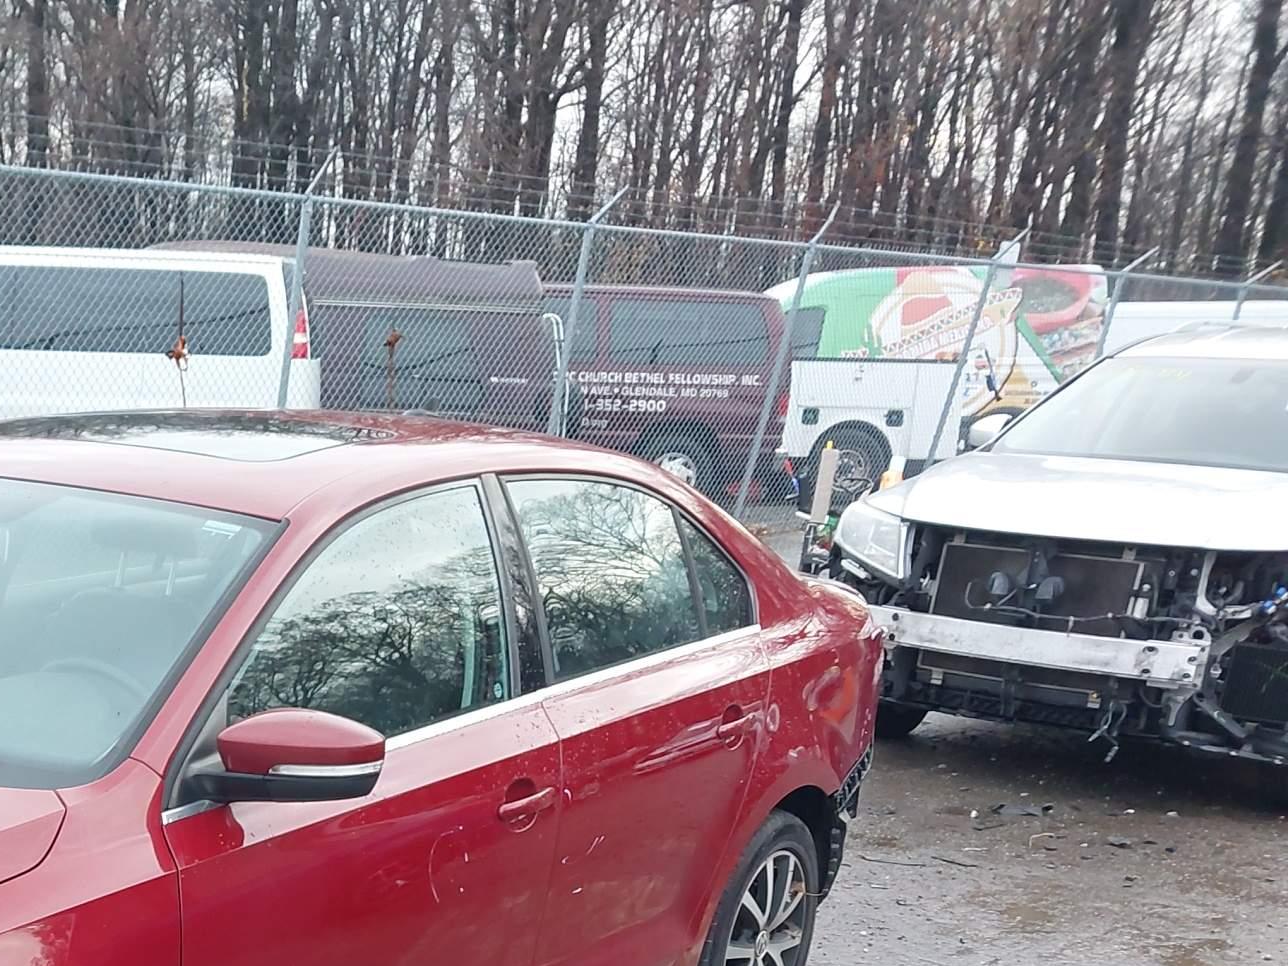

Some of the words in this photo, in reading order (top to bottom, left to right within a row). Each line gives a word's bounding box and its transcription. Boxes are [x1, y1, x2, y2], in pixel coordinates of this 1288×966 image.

[578, 372, 623, 384] CHURCH
[624, 372, 666, 384] BETHEL
[741, 375, 763, 386] INC.
[621, 386, 678, 398] GLENDALE,
[699, 388, 729, 399] 20769
